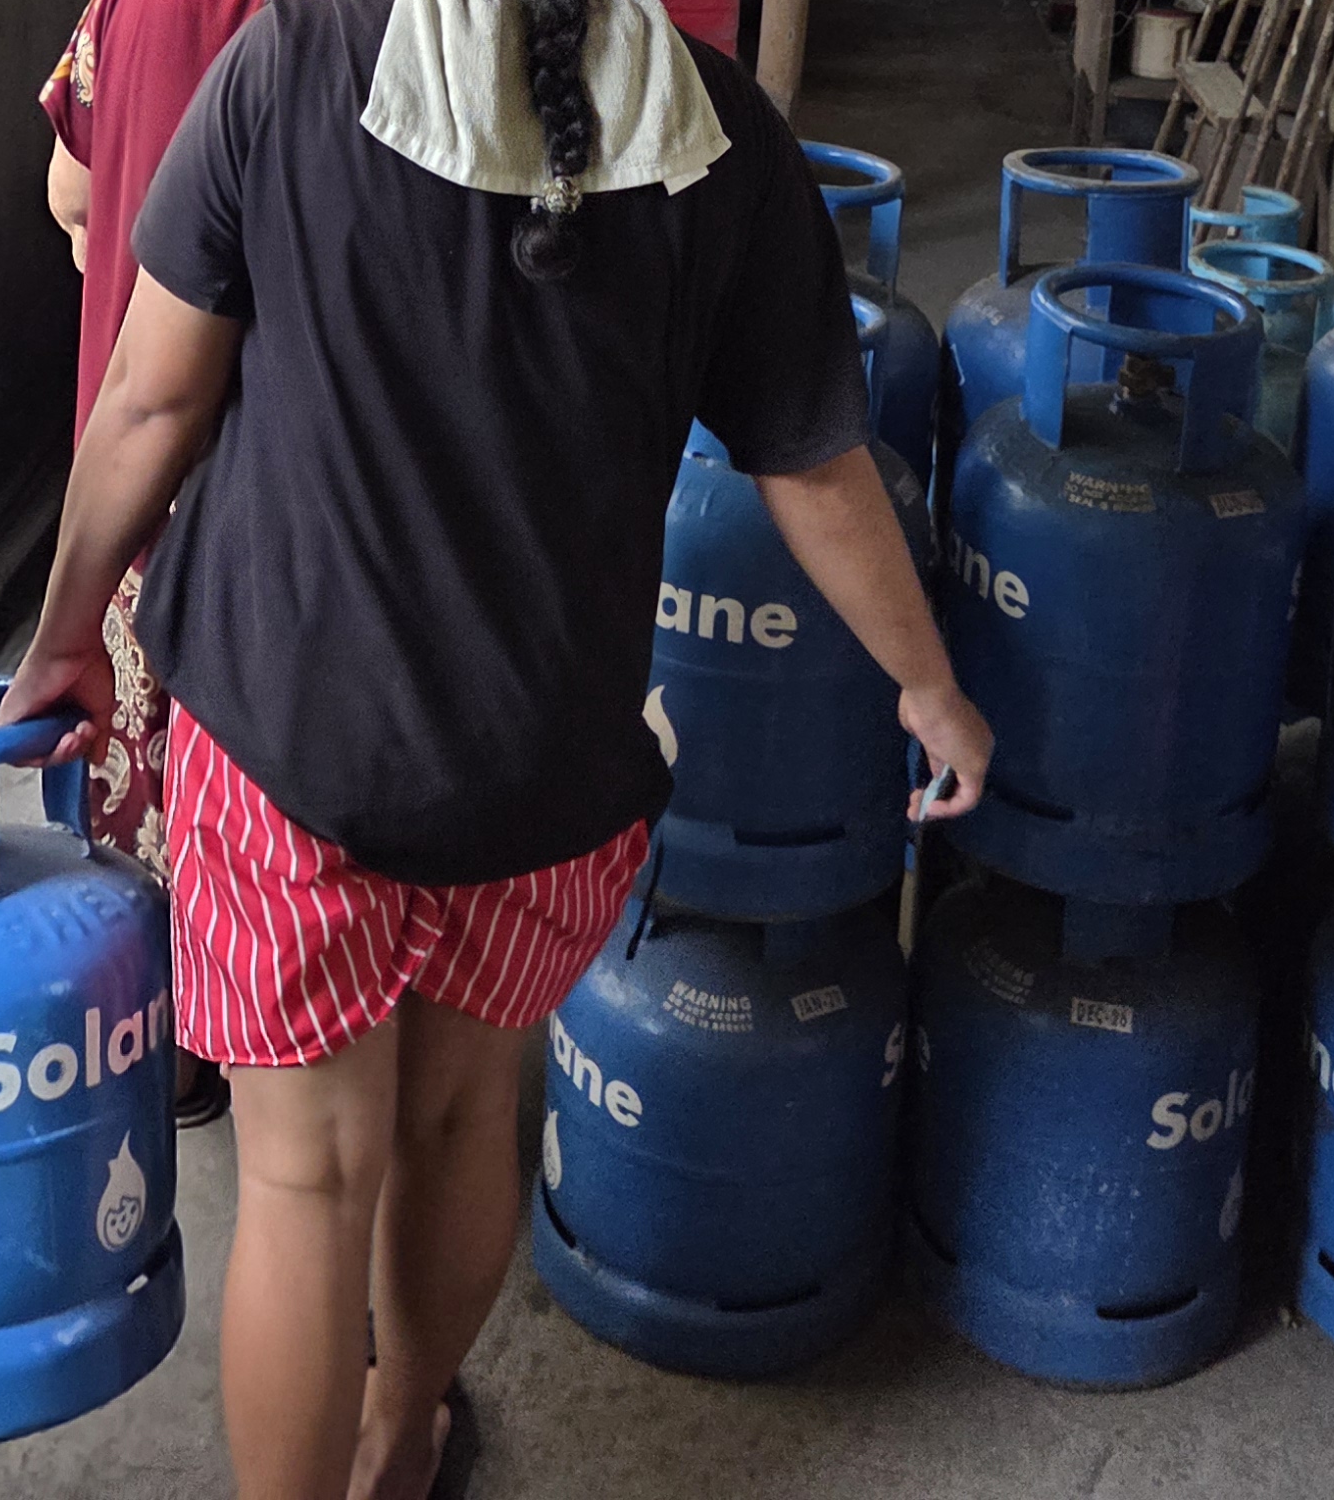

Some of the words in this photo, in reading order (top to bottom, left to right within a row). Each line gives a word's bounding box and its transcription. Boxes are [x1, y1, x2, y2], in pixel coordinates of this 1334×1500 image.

[655, 581, 798, 649] ane
[672, 979, 753, 1013] WARNING
[1145, 1067, 1258, 1151] Sola
